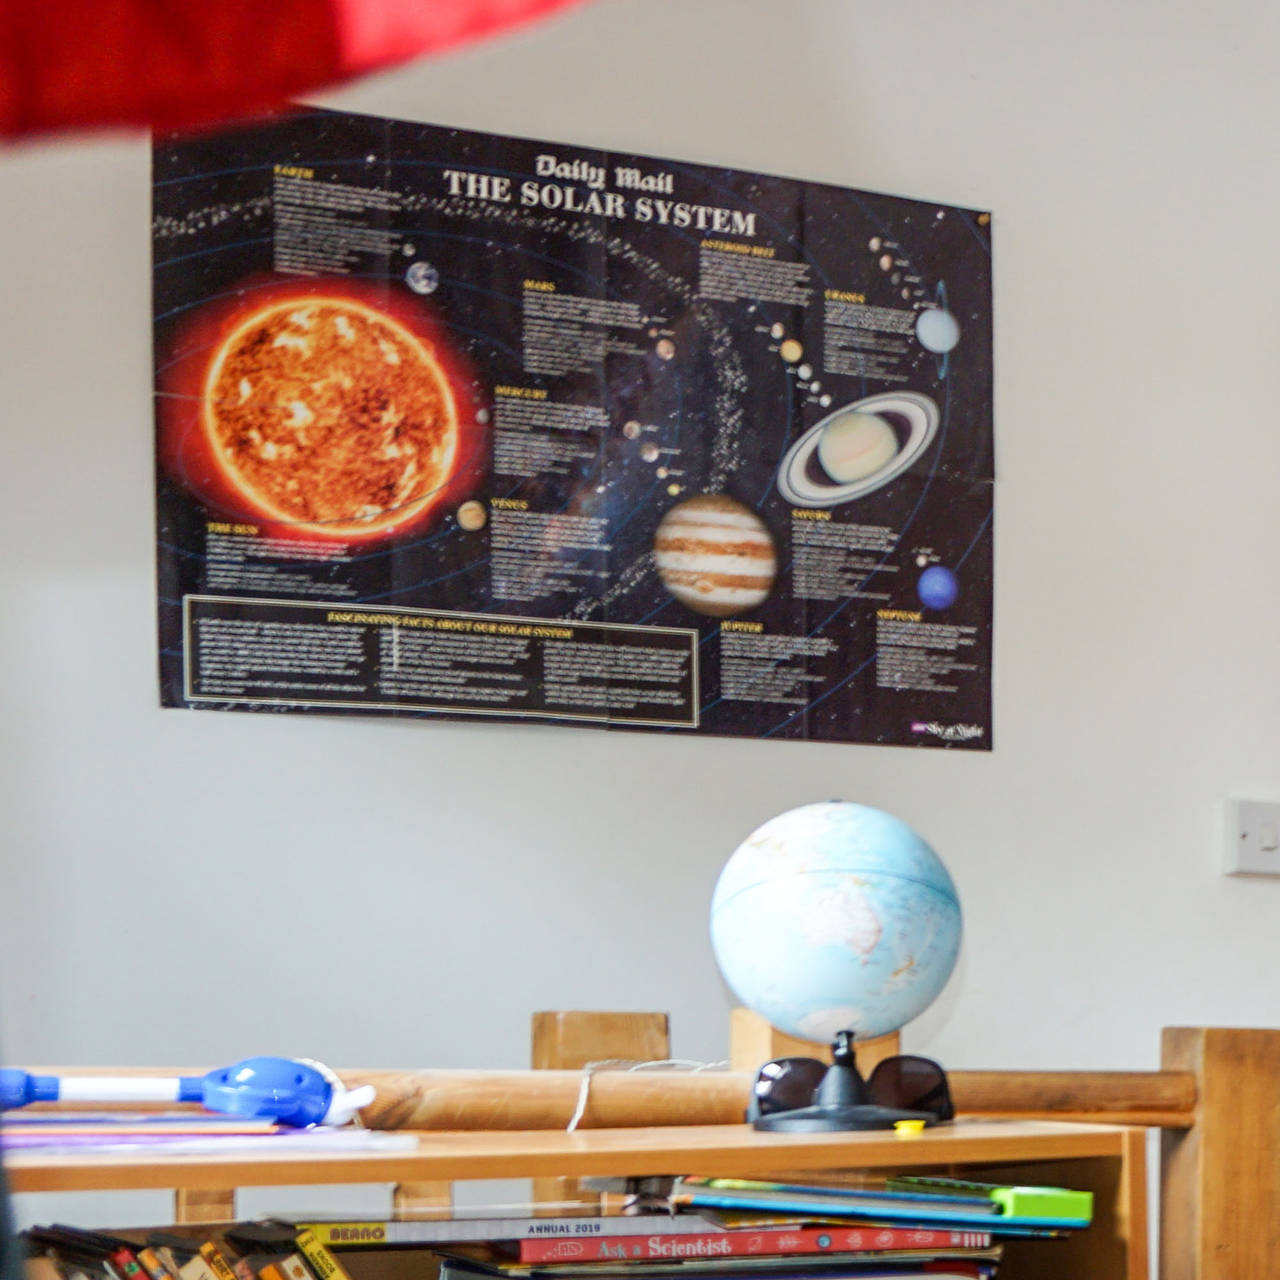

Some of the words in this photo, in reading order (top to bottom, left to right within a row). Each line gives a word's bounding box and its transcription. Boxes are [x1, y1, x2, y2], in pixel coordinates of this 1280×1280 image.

[535, 155, 606, 189] Daily
[615, 167, 674, 194] Mail
[443, 170, 512, 202] THE
[521, 181, 627, 219] SOLAR
[634, 198, 757, 237] SYSTEM
[329, 1227, 385, 1241] BEANO
[527, 1224, 571, 1236] ANNUAL
[599, 1242, 627, 1259] Ask
[648, 1238, 732, 1257] Scientist
